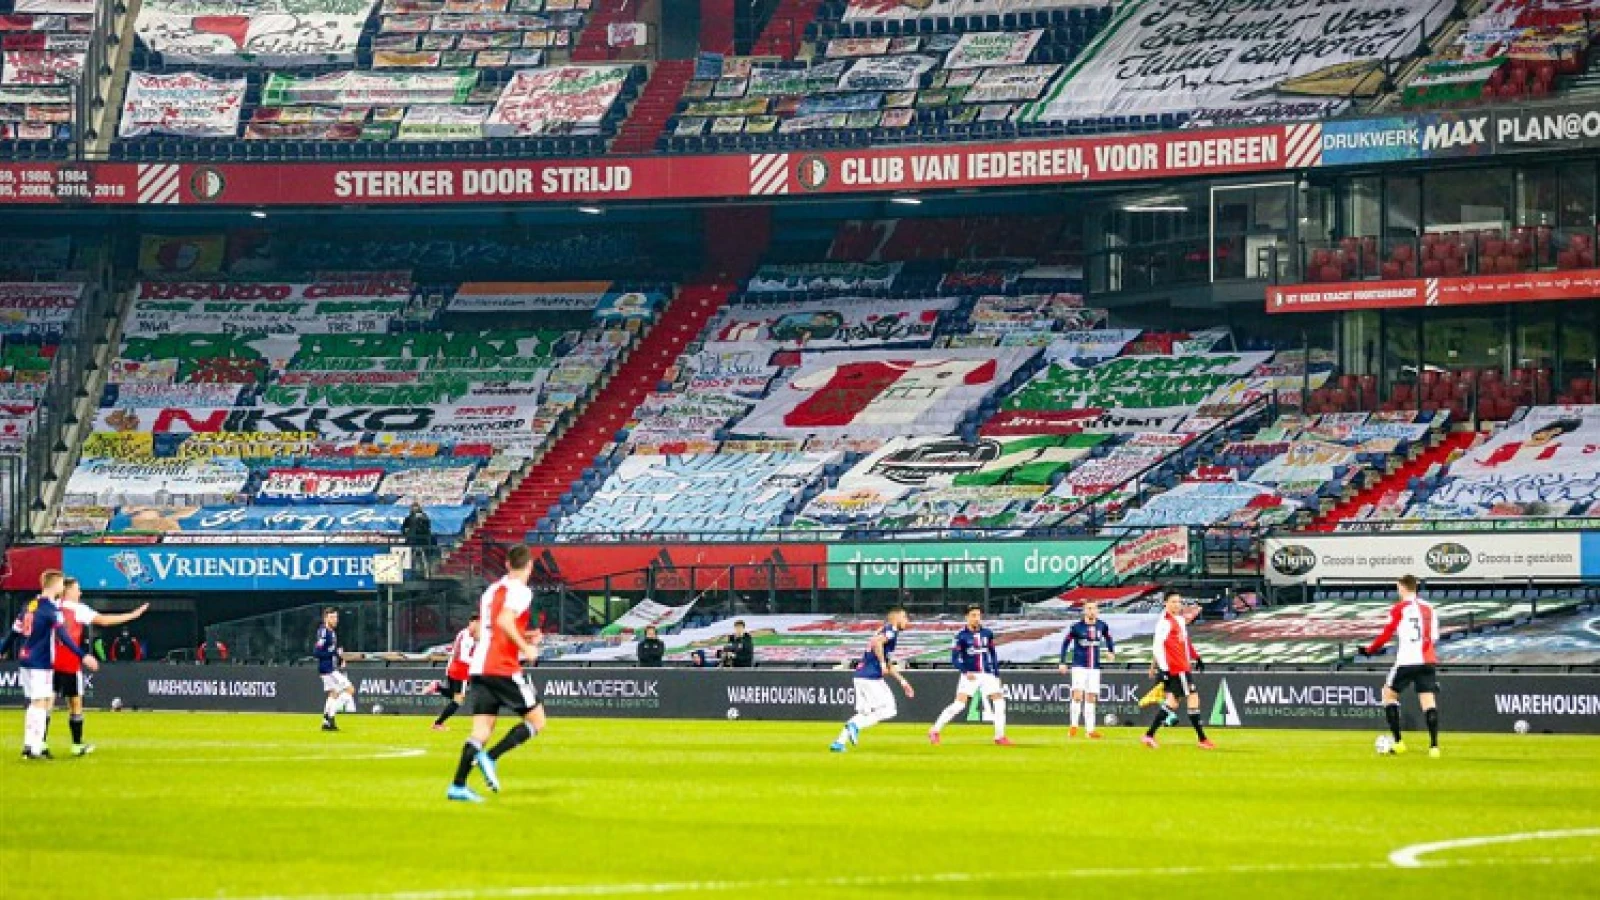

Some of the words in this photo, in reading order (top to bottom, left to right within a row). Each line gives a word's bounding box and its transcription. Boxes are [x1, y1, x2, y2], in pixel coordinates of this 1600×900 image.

[1324, 128, 1419, 150] DRUKWERK
[1422, 117, 1488, 150] MAX
[840, 157, 904, 184] CLUB
[911, 154, 959, 181] VAN
[968, 148, 1089, 180] IEDEREEN,
[1095, 142, 1158, 172] VOOR
[1165, 134, 1278, 169] IEDEREEN
[334, 170, 453, 197] STERKER
[462, 168, 533, 195] DOOR
[541, 166, 632, 193] STRIJD
[152, 407, 435, 432] NIKKO
[1409, 617, 1421, 642] 3
[148, 679, 217, 696] WAREHOUSING
[220, 680, 228, 696] &
[229, 681, 277, 697] LOGISTICS
[728, 685, 815, 703] WAREHOUSING
[818, 686, 827, 703] &
